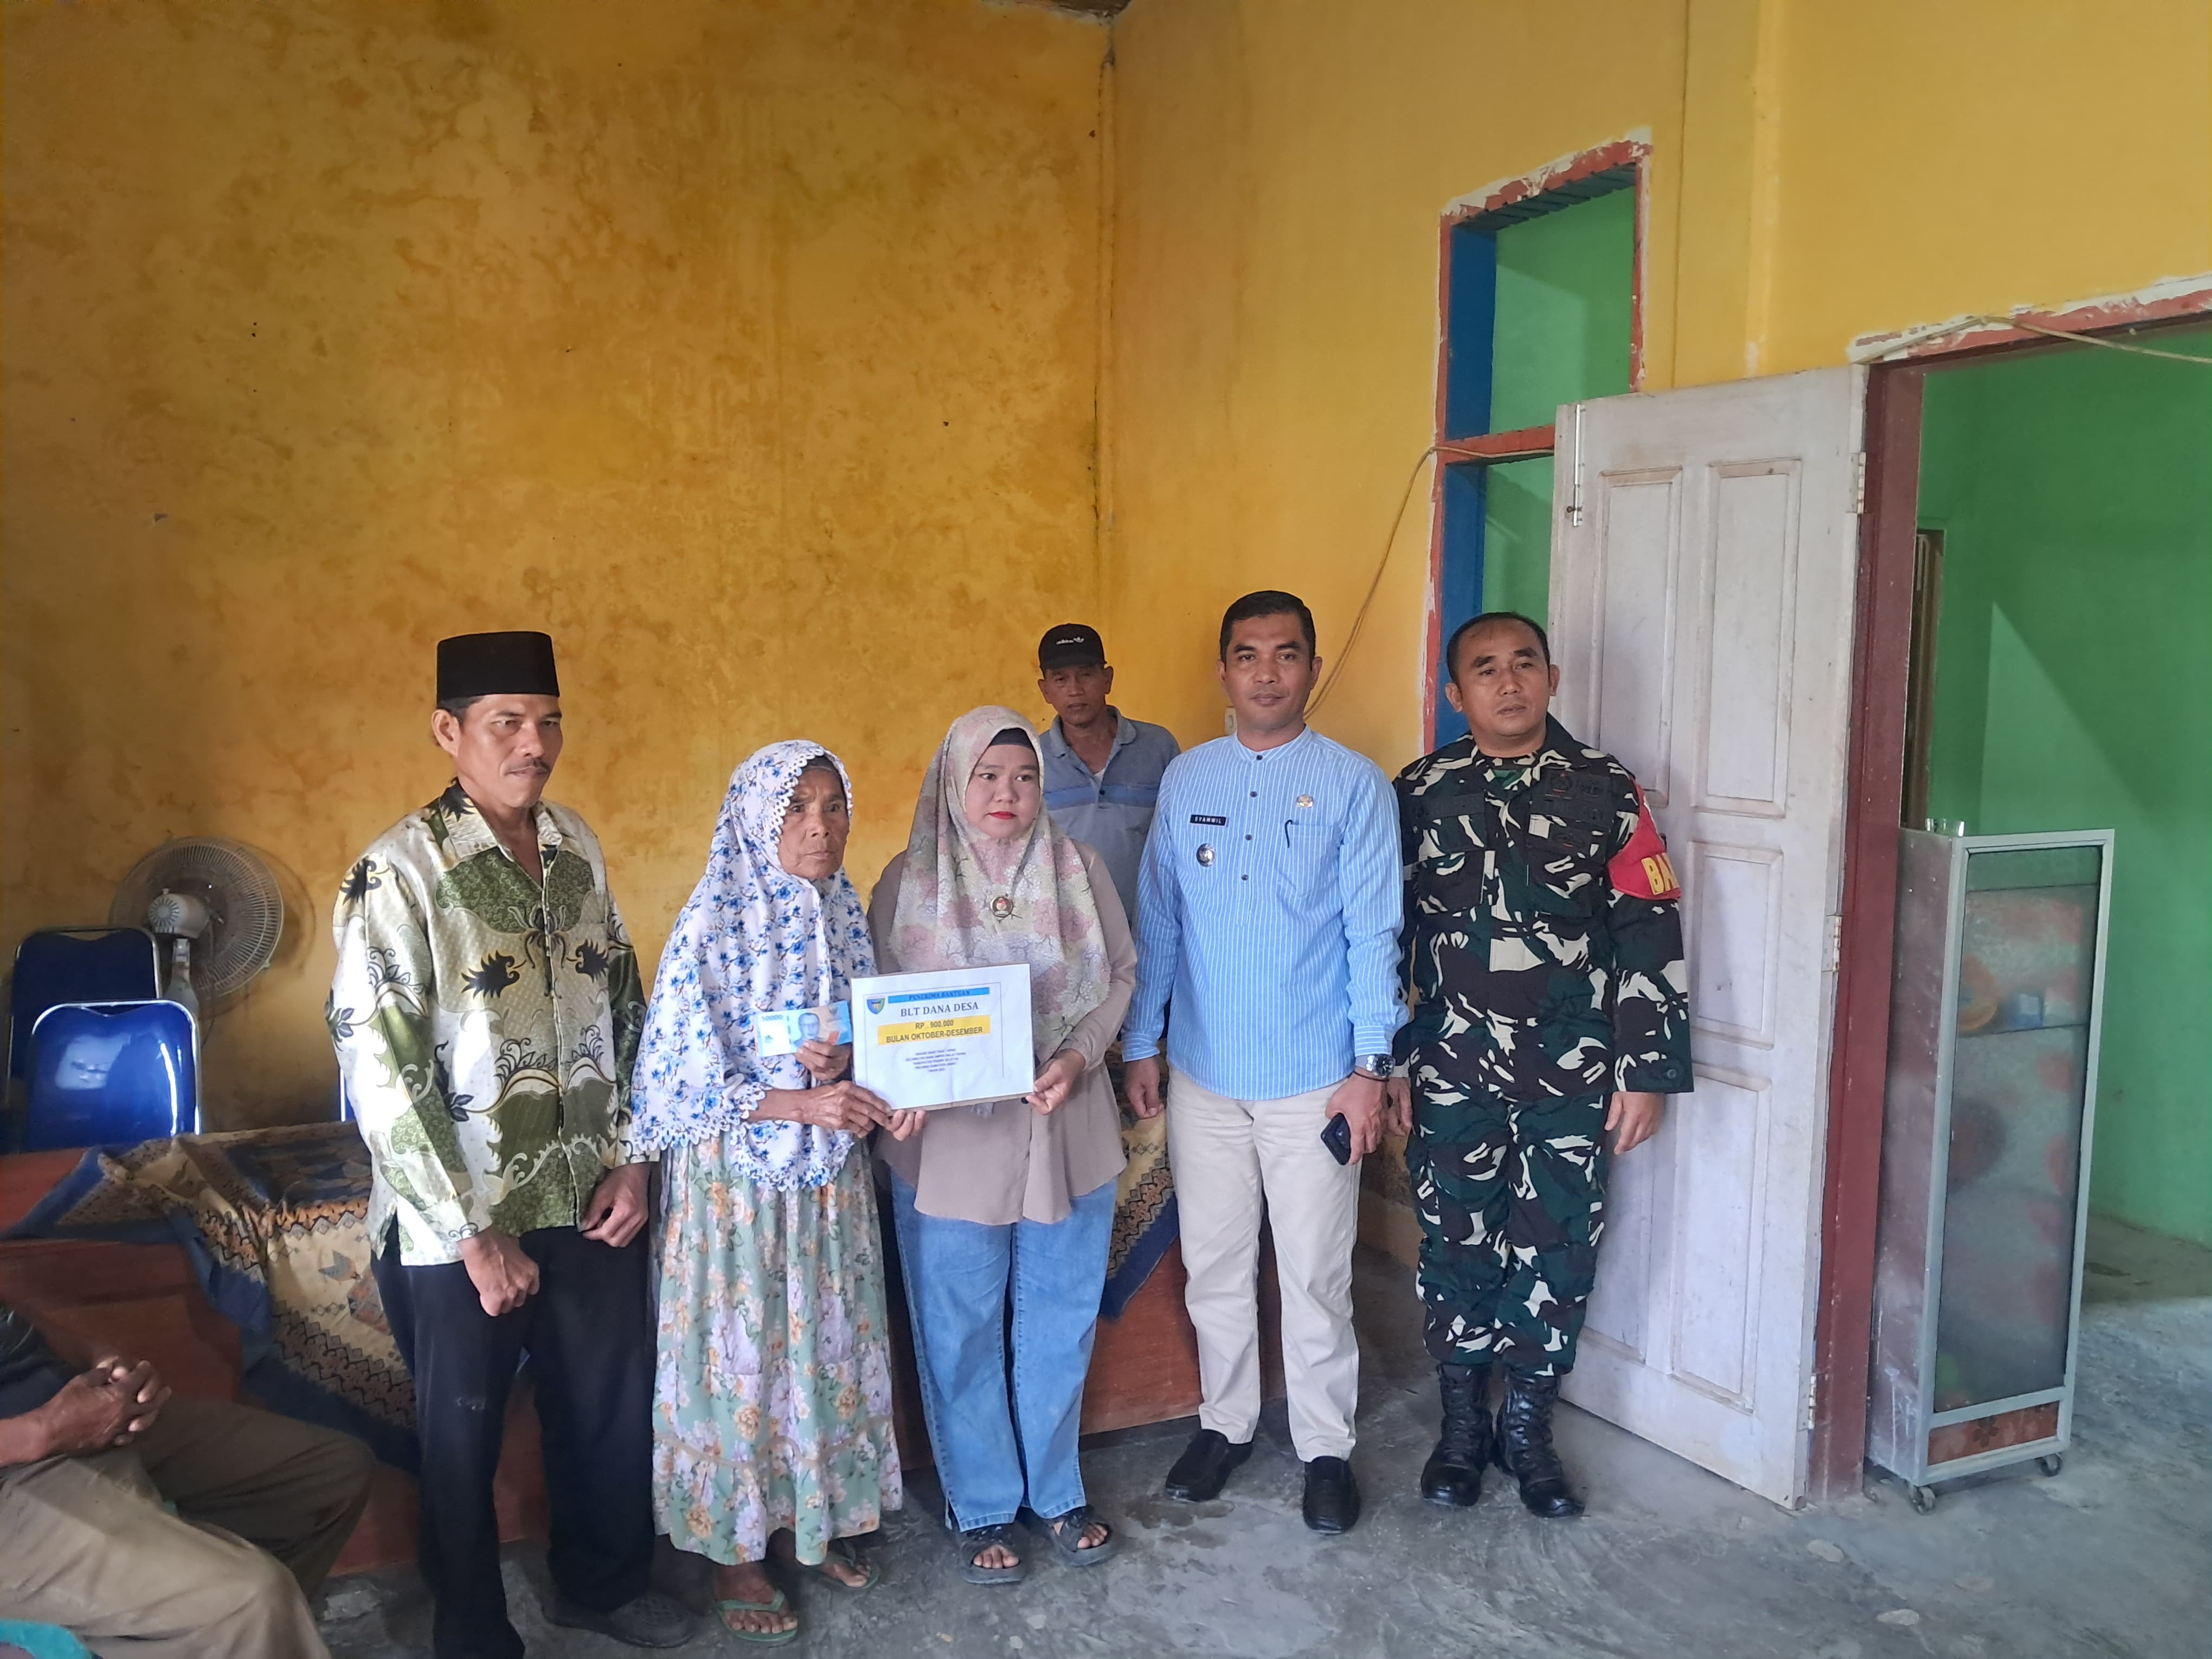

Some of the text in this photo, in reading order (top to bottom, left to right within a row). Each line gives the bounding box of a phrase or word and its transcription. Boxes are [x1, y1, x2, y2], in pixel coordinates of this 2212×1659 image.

[901, 1001, 979, 1017] BLT DANA DESA
[930, 1019, 954, 1028] 900.000
[886, 1026, 983, 1043] BULAN OKTOBER-DESEMBER
